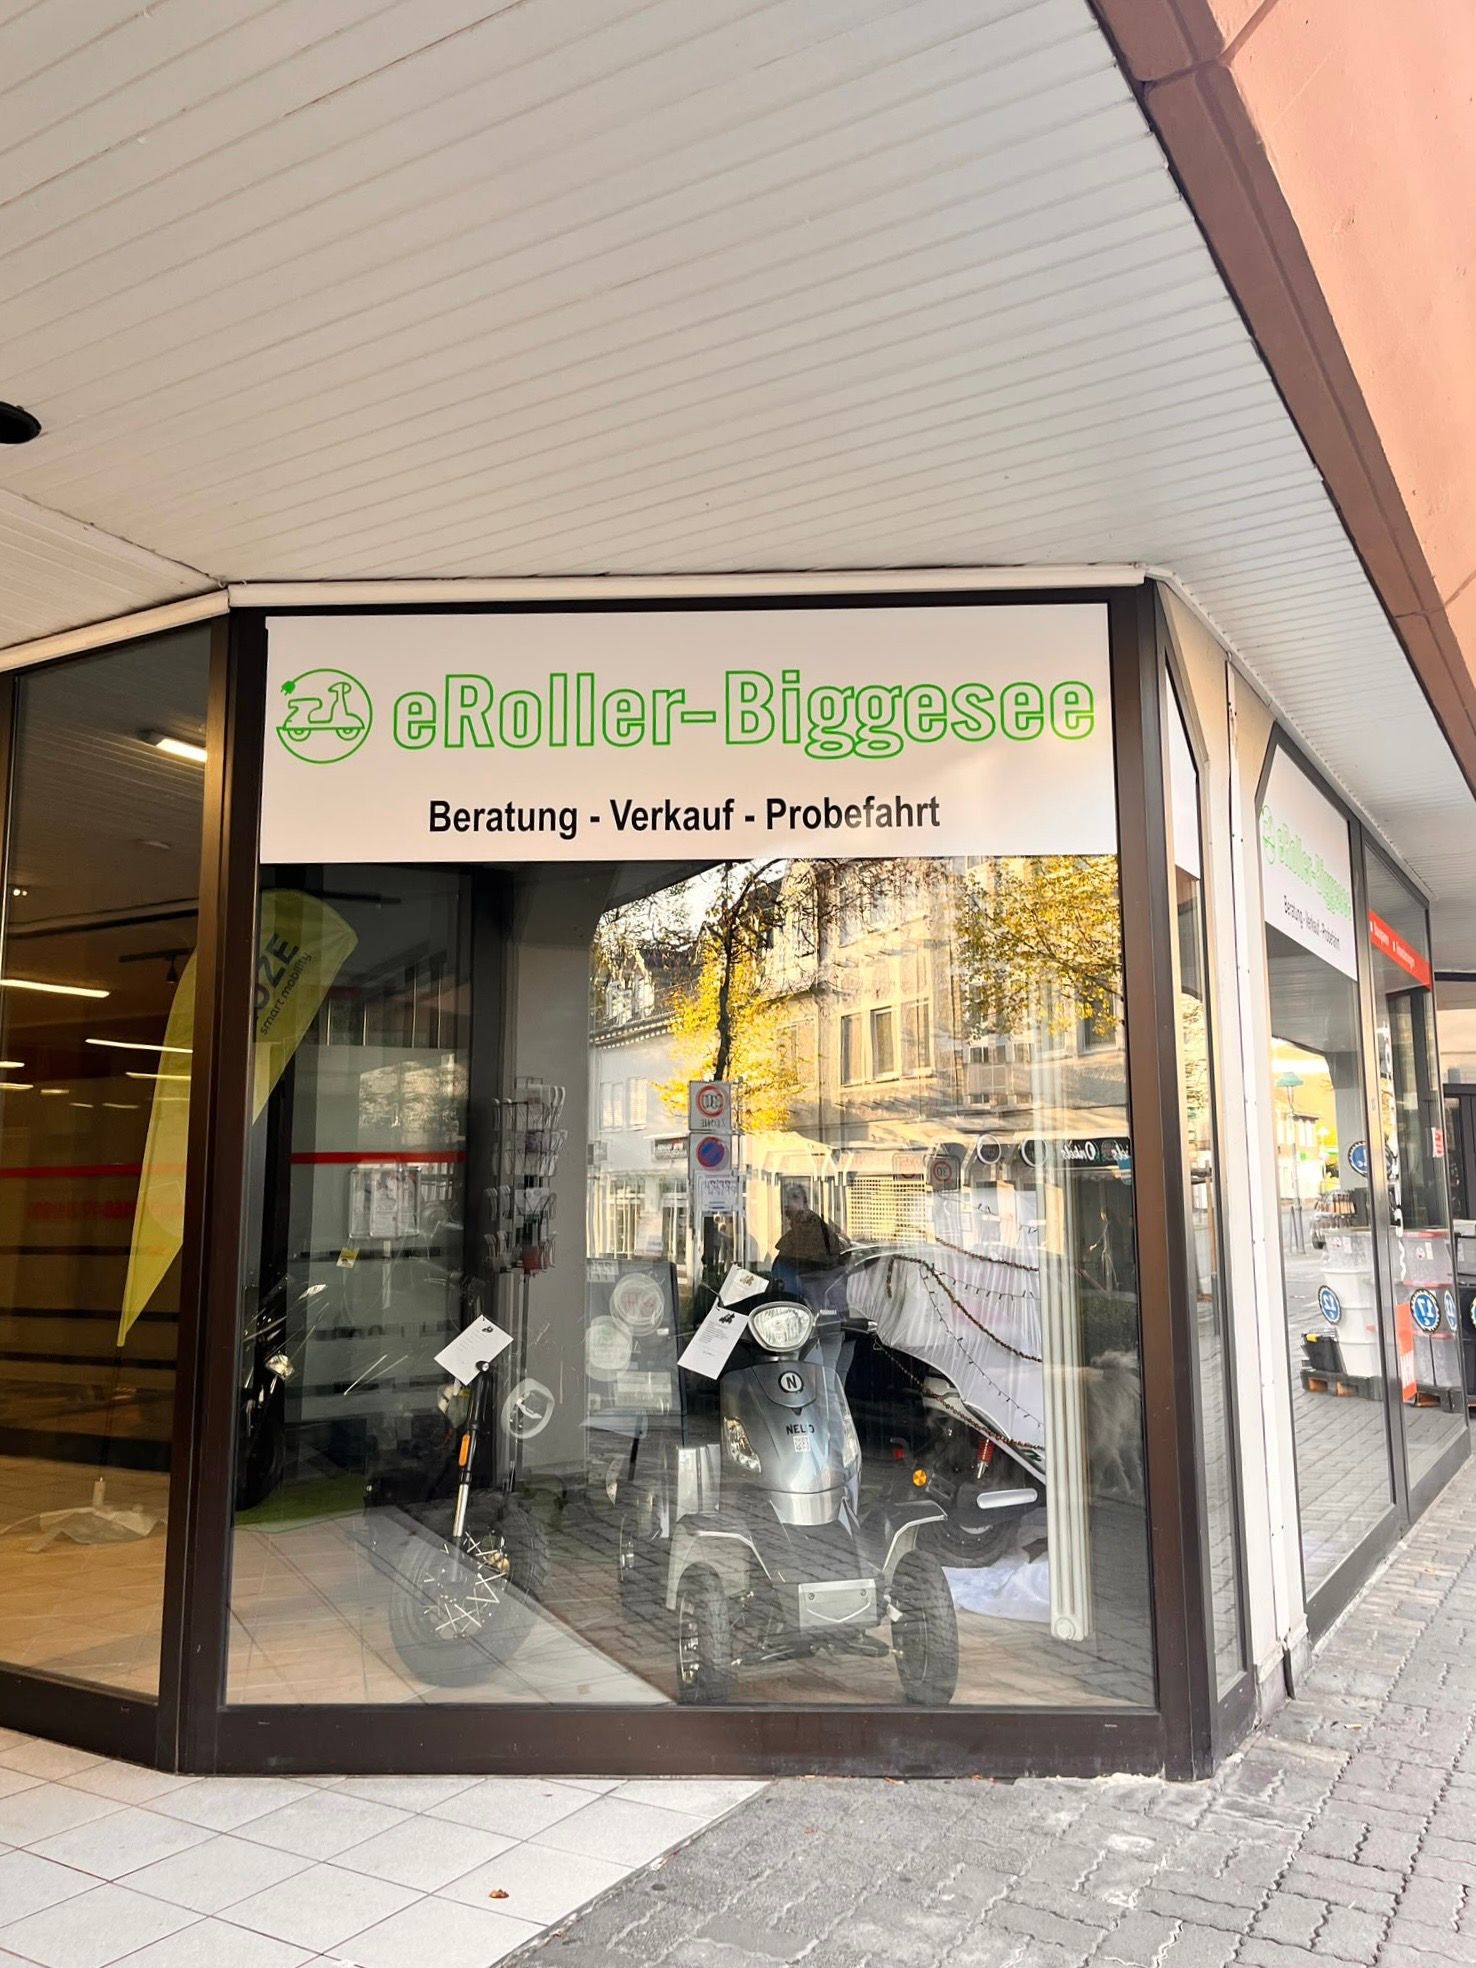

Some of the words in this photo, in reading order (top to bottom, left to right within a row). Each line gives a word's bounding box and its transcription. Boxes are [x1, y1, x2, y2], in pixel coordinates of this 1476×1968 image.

[393, 669, 1094, 761] eRoller-Biggesee
[429, 800, 577, 840] Beratung
[609, 798, 735, 832] Verkauf
[766, 795, 940, 830] Probefahrt
[260, 1000, 285, 1035] smart
[282, 952, 312, 1000] mobility
